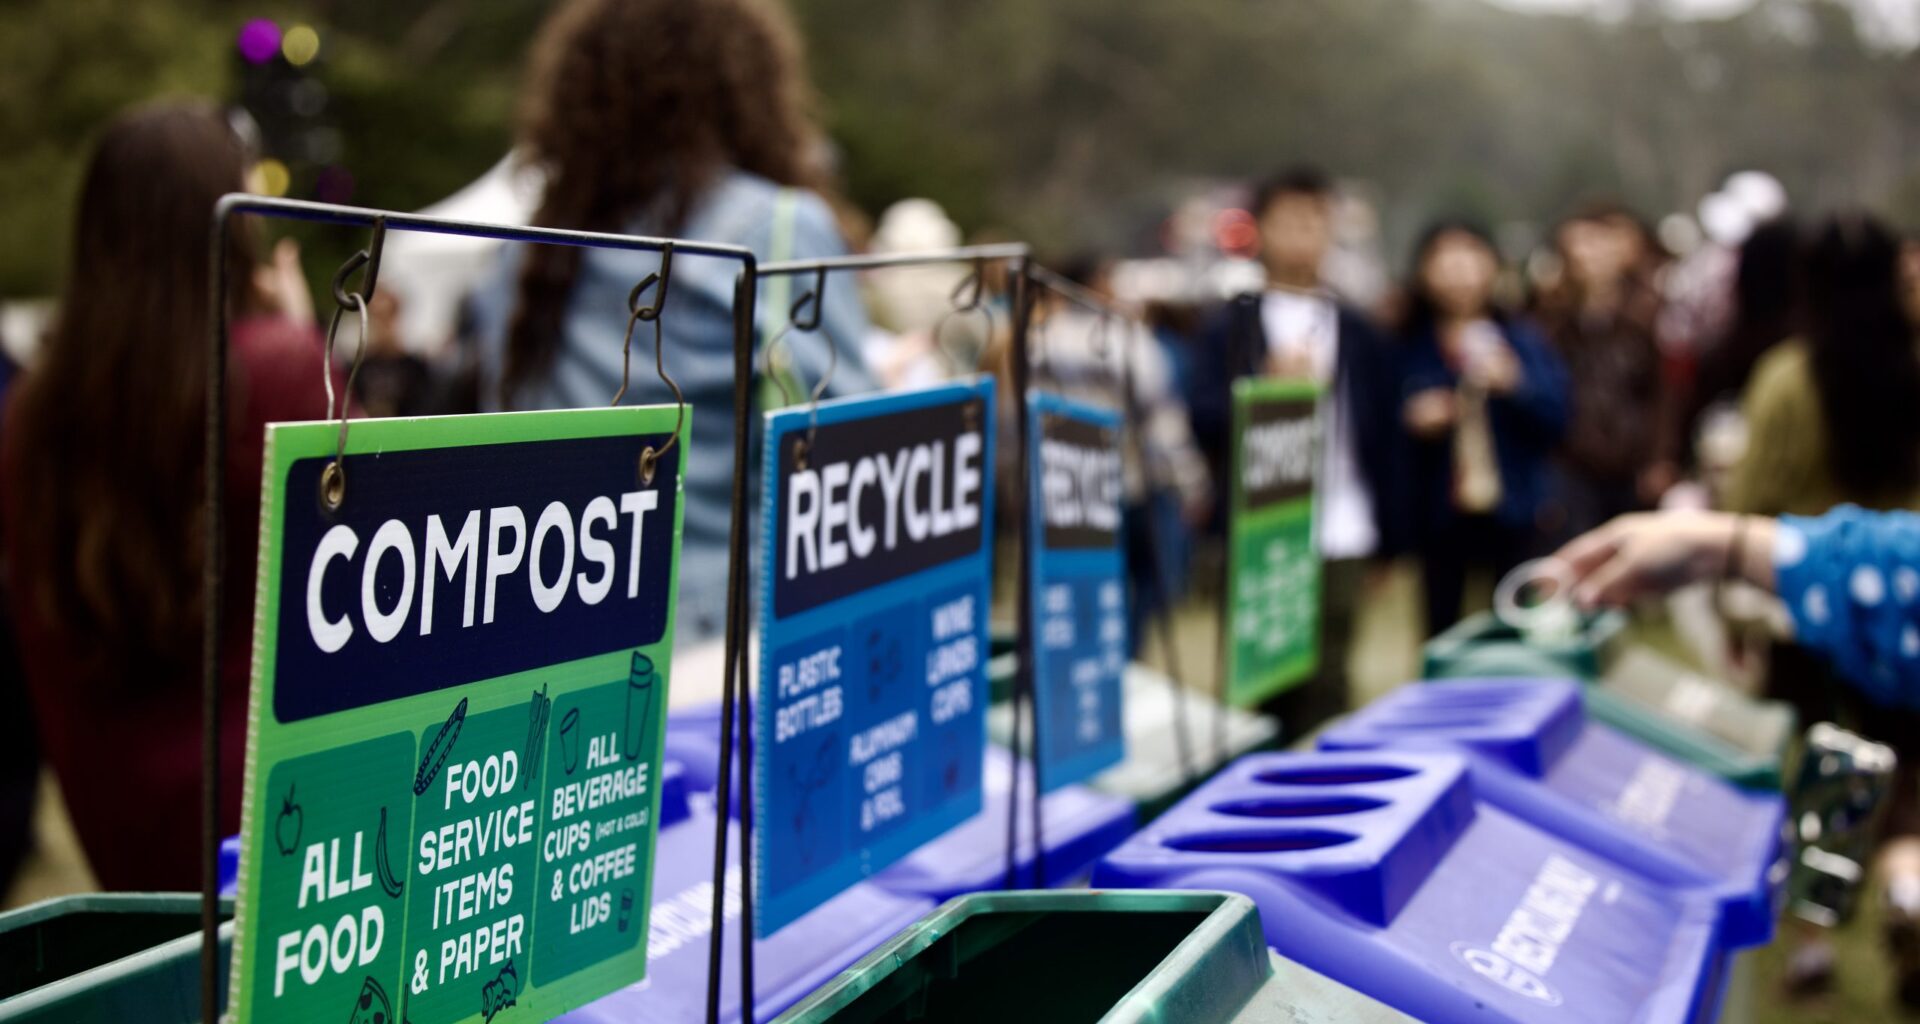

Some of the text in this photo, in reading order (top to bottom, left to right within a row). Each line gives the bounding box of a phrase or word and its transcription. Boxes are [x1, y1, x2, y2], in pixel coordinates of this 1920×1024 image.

[785, 432, 981, 580] RECYCLE
[306, 490, 658, 653] COMPOST
[778, 645, 842, 700] PLASTIC
[775, 685, 843, 743] BOTTLES
[444, 750, 519, 810] FOOD
[586, 732, 620, 770] ALL
[552, 762, 649, 821] BEVERAGE
[418, 800, 536, 875] SERVICE
[543, 806, 650, 863] CUPS (HOT & COLD)
[297, 831, 374, 909] ALL
[432, 863, 514, 930] ITEMS
[550, 843, 637, 902] & COFFEE
[569, 891, 611, 936] LIDS
[274, 905, 385, 998] FOOD
[410, 913, 525, 996] & PAPER
